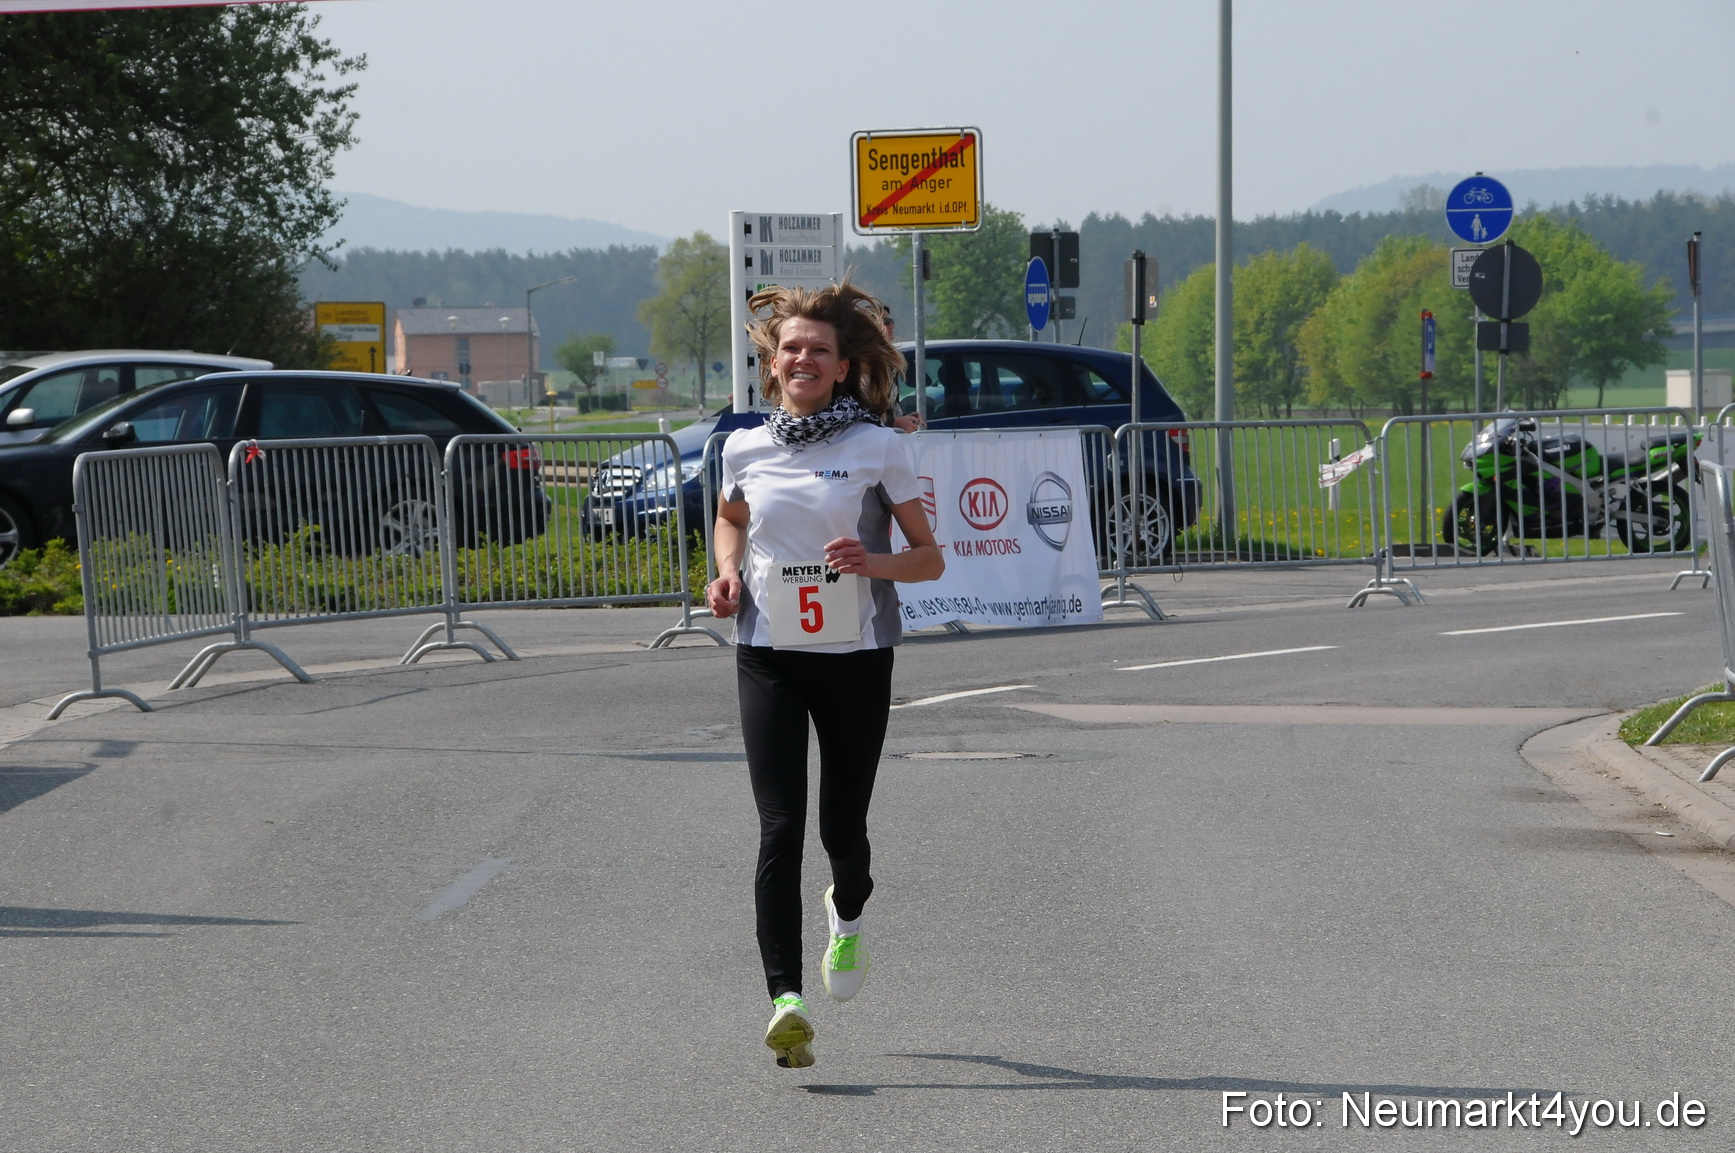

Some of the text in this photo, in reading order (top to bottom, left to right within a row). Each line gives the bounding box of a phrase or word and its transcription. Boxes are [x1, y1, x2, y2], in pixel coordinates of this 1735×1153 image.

[868, 146, 965, 176] Sengenthal
[881, 176, 953, 193] am Anger
[866, 203, 888, 216] Kreis
[892, 202, 935, 215] Neumarkt
[778, 216, 821, 230] HOLZAMMER
[779, 249, 822, 263] HOLZAMMER
[967, 491, 1000, 518] KIA
[953, 540, 973, 557] KIA
[975, 538, 1022, 556] MOTORS
[782, 565, 822, 577] MEYER
[782, 575, 823, 584] WERBUNG
[798, 585, 824, 634] 5
